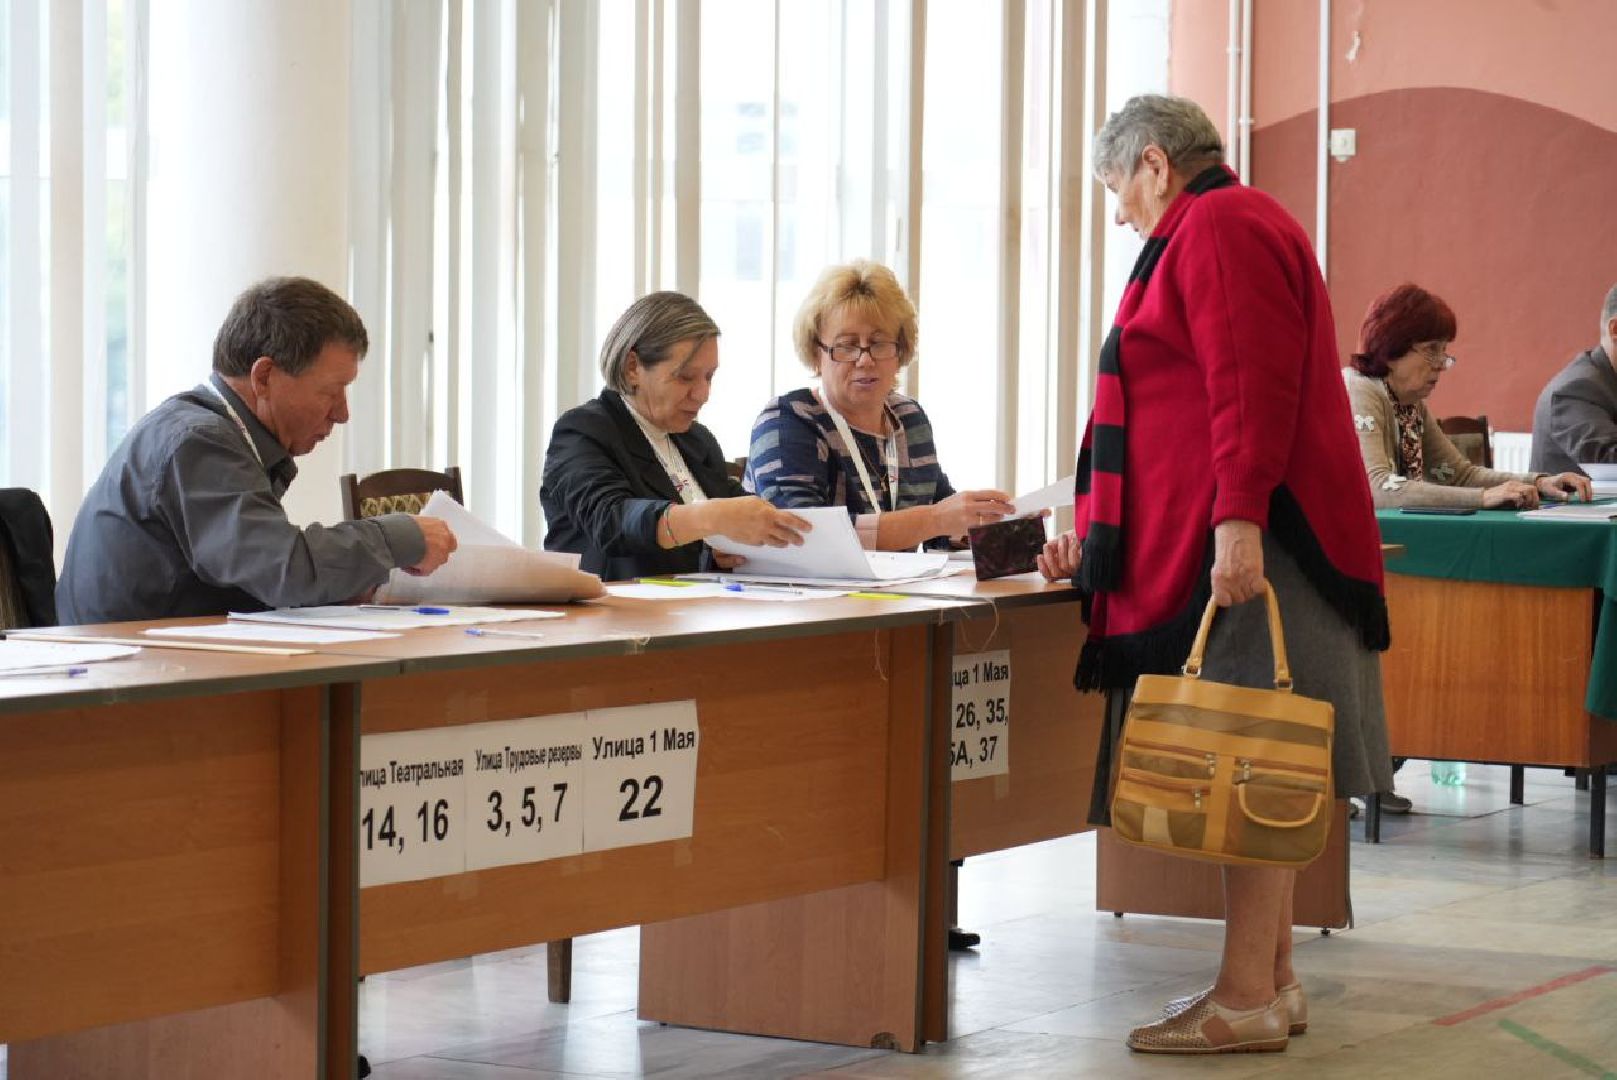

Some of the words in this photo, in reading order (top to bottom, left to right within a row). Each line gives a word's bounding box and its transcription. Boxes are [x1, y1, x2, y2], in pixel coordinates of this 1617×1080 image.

[951, 669, 969, 688] ца
[972, 663, 979, 684] 1
[983, 661, 1009, 683] Мая
[956, 702, 980, 731] 26,
[986, 698, 1009, 726] 35,
[475, 749, 503, 772] Улица
[504, 746, 546, 773] Трудовые
[548, 744, 583, 769] резервы
[592, 736, 645, 760] Улица
[649, 730, 657, 753] 1
[663, 727, 695, 751] Мая
[979, 736, 998, 762] 37
[389, 759, 464, 786] Театральная
[486, 790, 511, 837] 3,
[521, 786, 542, 832] 5,
[553, 783, 568, 822] 7
[618, 775, 664, 822] 22
[362, 805, 405, 854] 14,
[417, 799, 449, 842] 16
